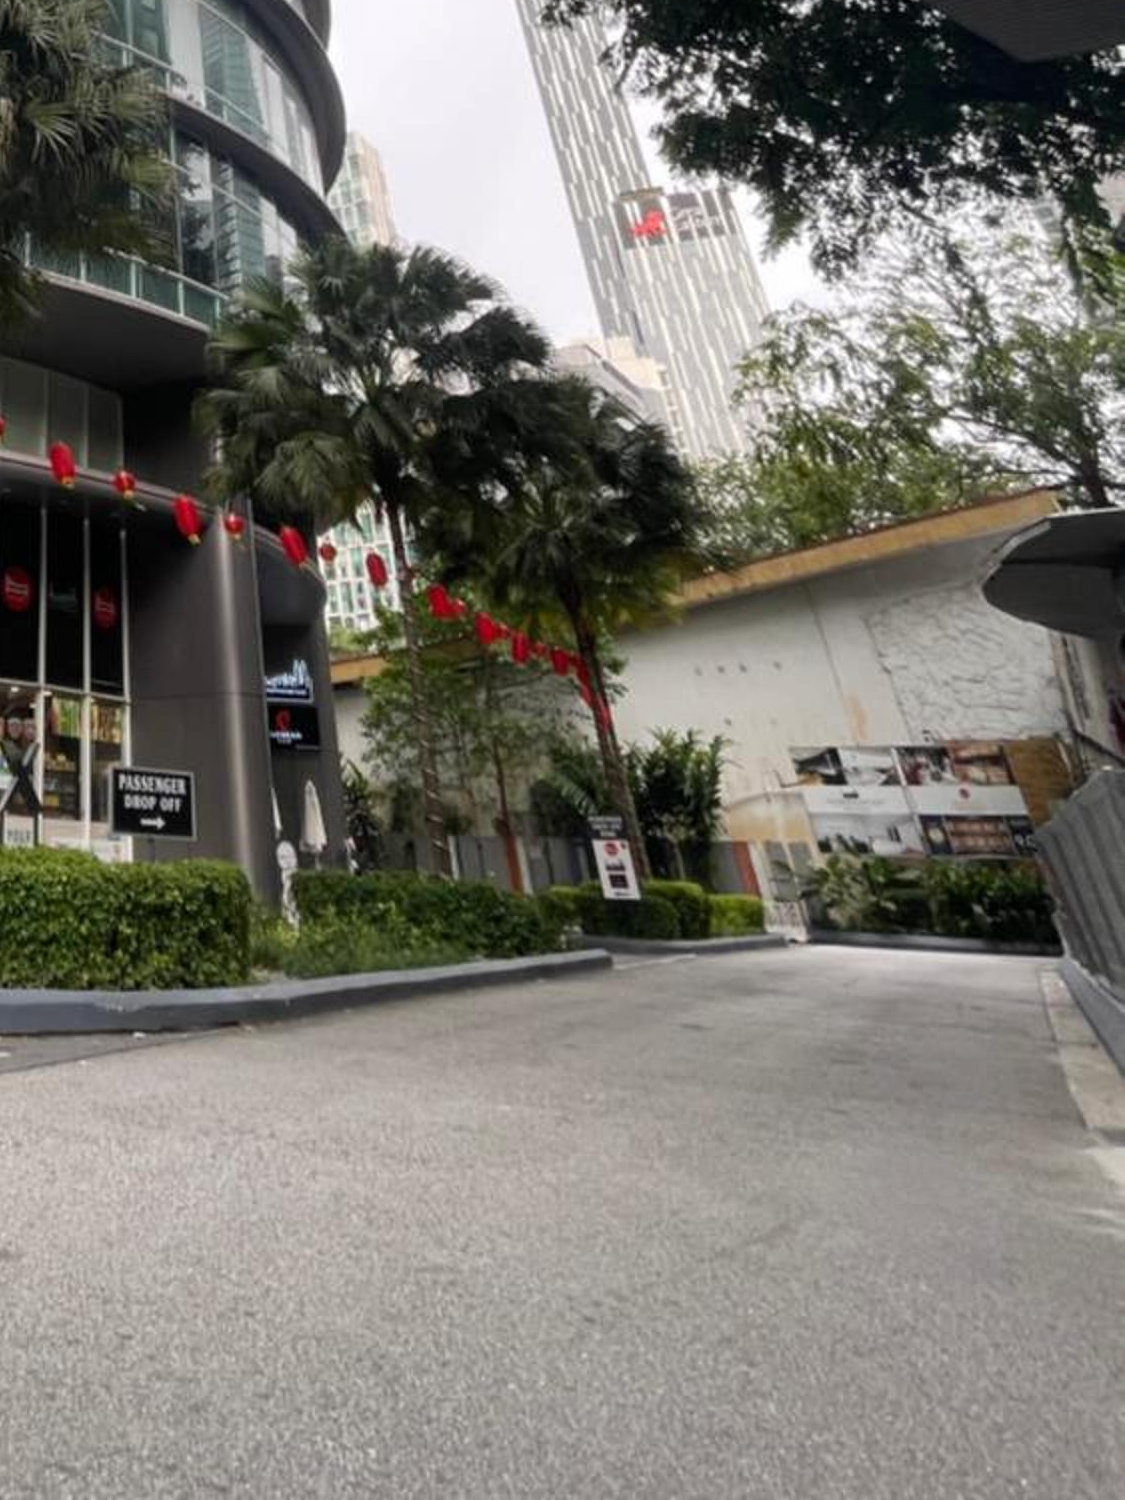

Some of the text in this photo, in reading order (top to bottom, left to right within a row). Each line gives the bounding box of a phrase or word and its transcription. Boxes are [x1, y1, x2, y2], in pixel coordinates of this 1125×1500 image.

[118, 773, 186, 794] PASSENGER
[124, 794, 181, 812] DROP OFF
